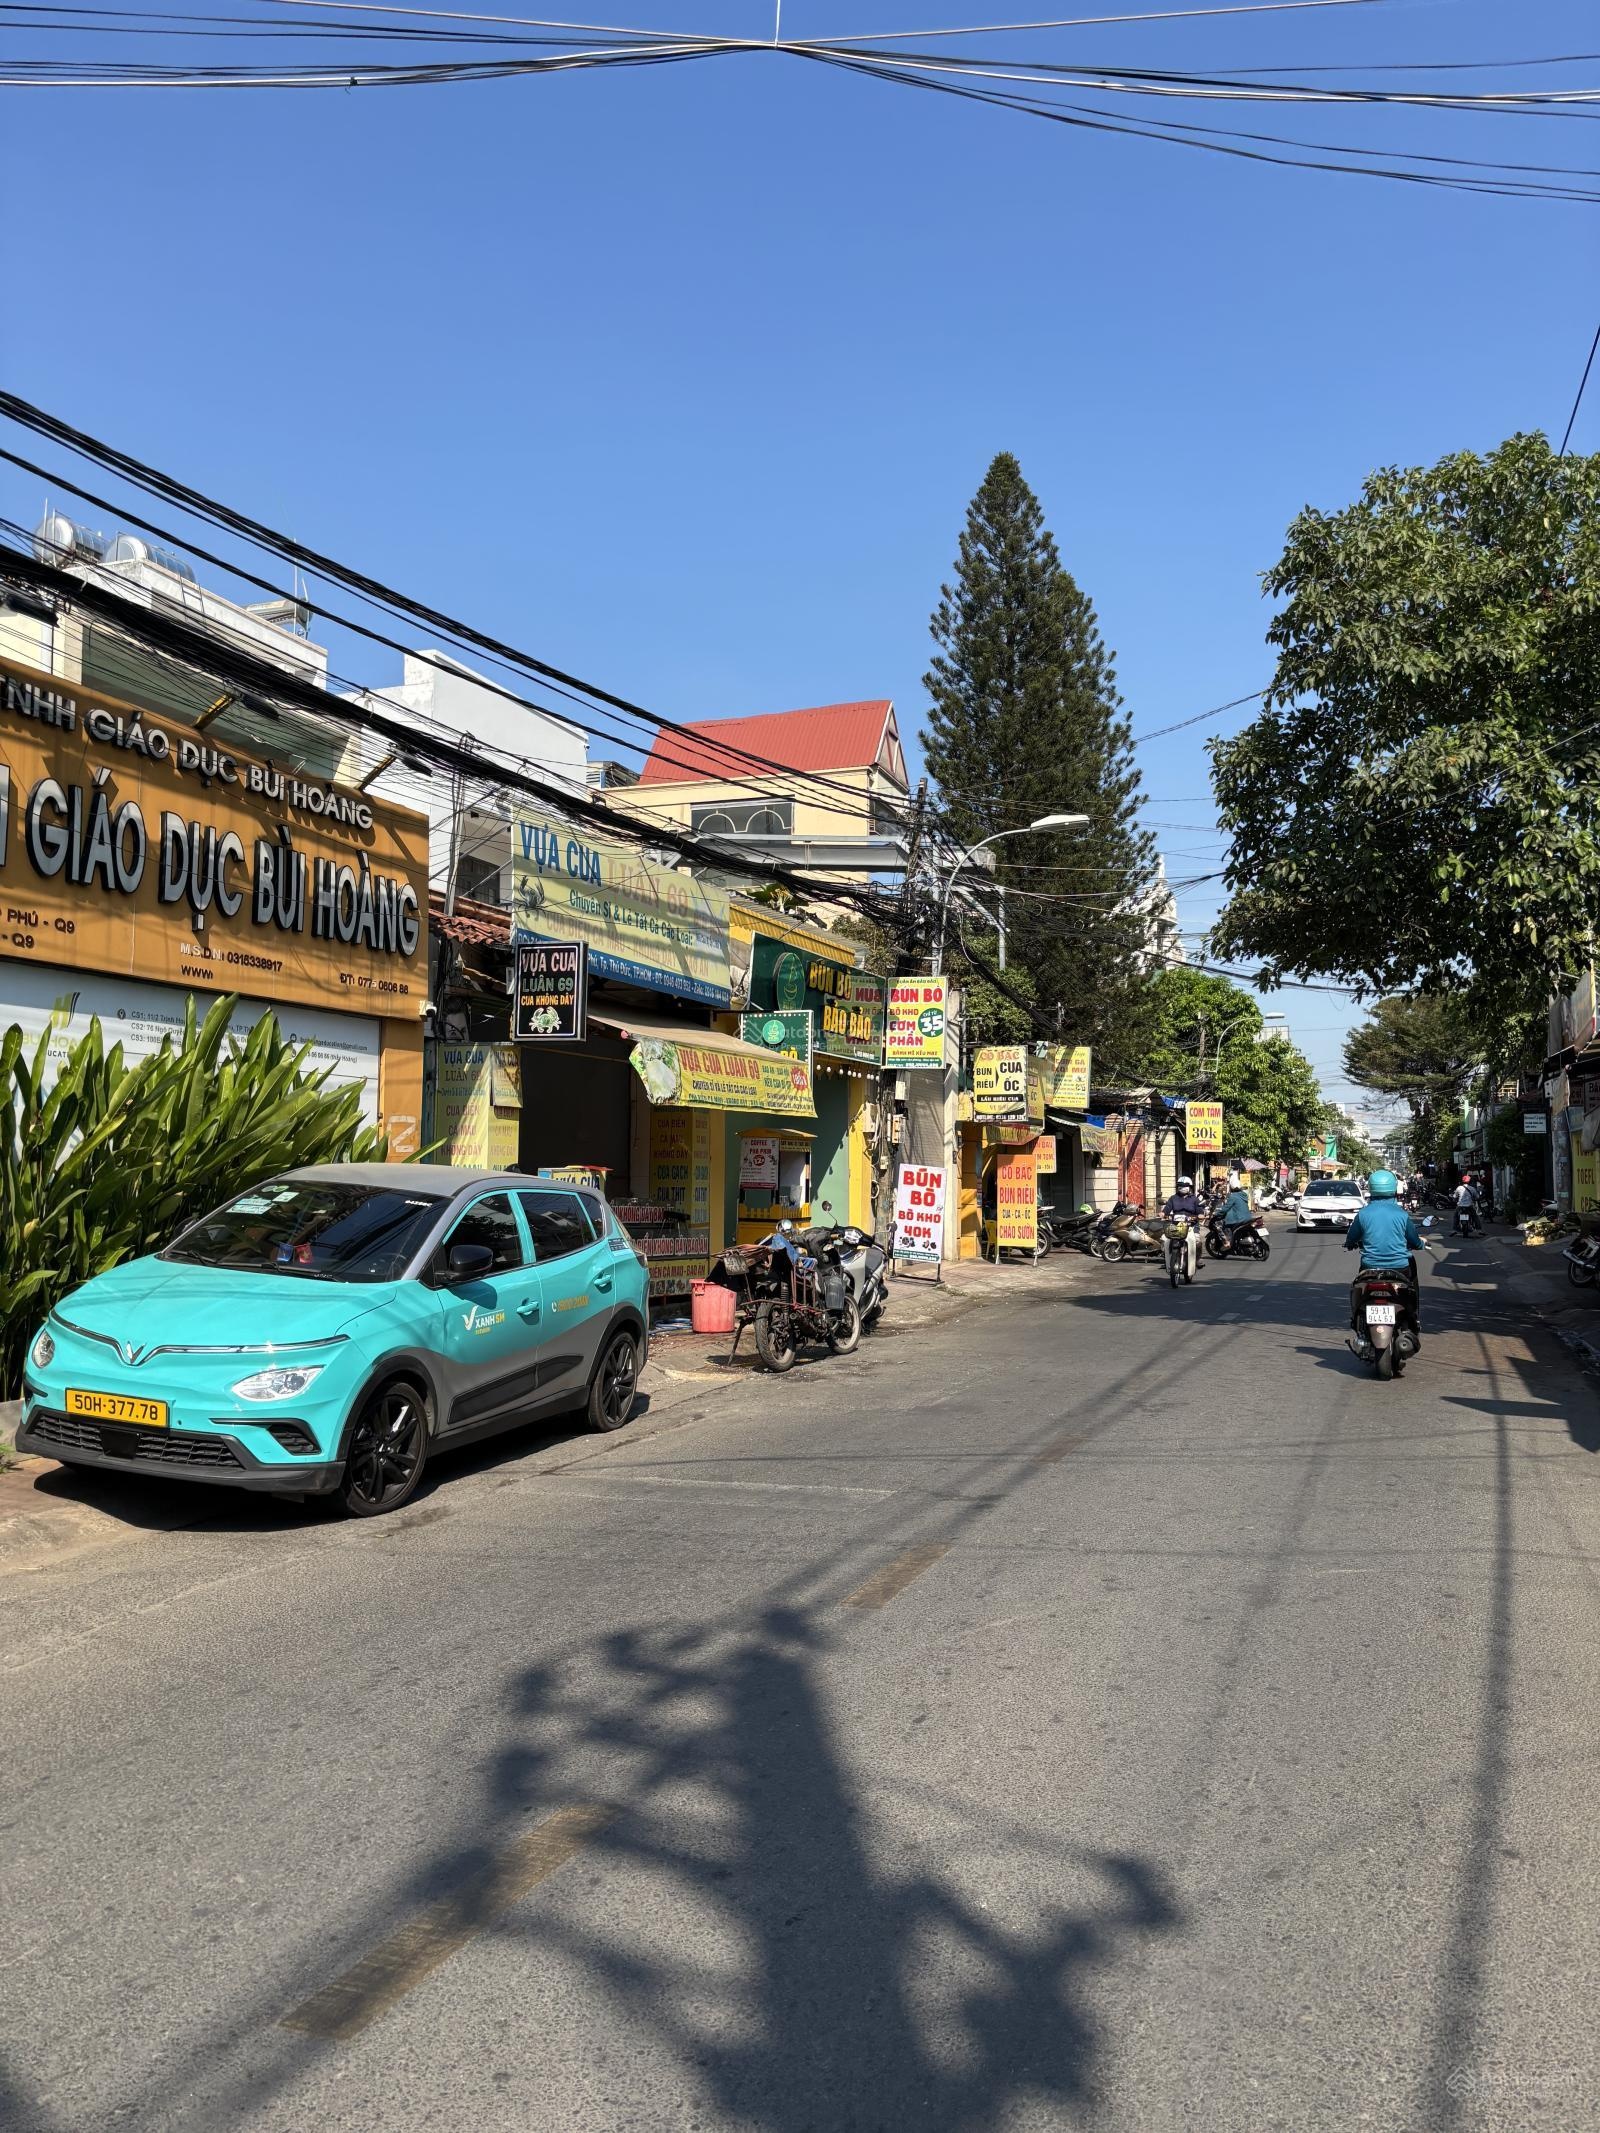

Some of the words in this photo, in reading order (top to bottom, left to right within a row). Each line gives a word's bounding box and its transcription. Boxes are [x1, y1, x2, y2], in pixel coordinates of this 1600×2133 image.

[85, 710, 170, 760] GIÁO
[178, 738, 239, 788] DỤC
[249, 758, 285, 801] BÙI
[289, 783, 374, 830] HOÀNG
[25, 766, 147, 895] GIÁO
[158, 810, 245, 932] DỤC
[252, 824, 307, 933] BÙI
[311, 849, 420, 957] HOÀNG
[519, 820, 561, 874] VỰA
[566, 840, 602, 887] CUA
[569, 889, 602, 917] Chuyên
[6, 908, 39, 928] PHÚ
[54, 917, 76, 934] Q9
[12, 932, 35, 949] Q9
[522, 949, 547, 977] VỰA
[550, 951, 576, 972] CUA
[522, 974, 554, 993] LUÂN
[557, 976, 574, 992] 69
[808, 959, 834, 995] BÚN
[521, 995, 535, 1006] CUA
[535, 992, 559, 1006] KHÔNG
[560, 992, 575, 1006] DÂY
[890, 985, 919, 1003] BÚN
[923, 985, 943, 1003] BÒ
[823, 999, 847, 1036] BẢO
[849, 1006, 872, 1041] BẢO
[902, 1008, 918, 1016] KHO
[889, 1020, 916, 1032] CƠM
[920, 1015, 943, 1033] 35
[889, 1031, 923, 1046] PHẦN
[679, 1049, 701, 1076] VỰA
[702, 1051, 723, 1076] CUA
[749, 1057, 760, 1080] 69
[1000, 1062, 1023, 1073] CUA
[1004, 1076, 1020, 1091] ỐC
[1192, 1126, 1217, 1139] 30k
[903, 1168, 942, 1188] BÚN
[1577, 1168, 1596, 1184] TOEFL
[910, 1188, 936, 1207] BÒ
[898, 1208, 914, 1220] BÒ
[916, 1212, 942, 1223] KHO
[904, 1225, 932, 1239] 40K
[475, 1315, 495, 1329] XANH
[495, 1312, 505, 1324] SM
